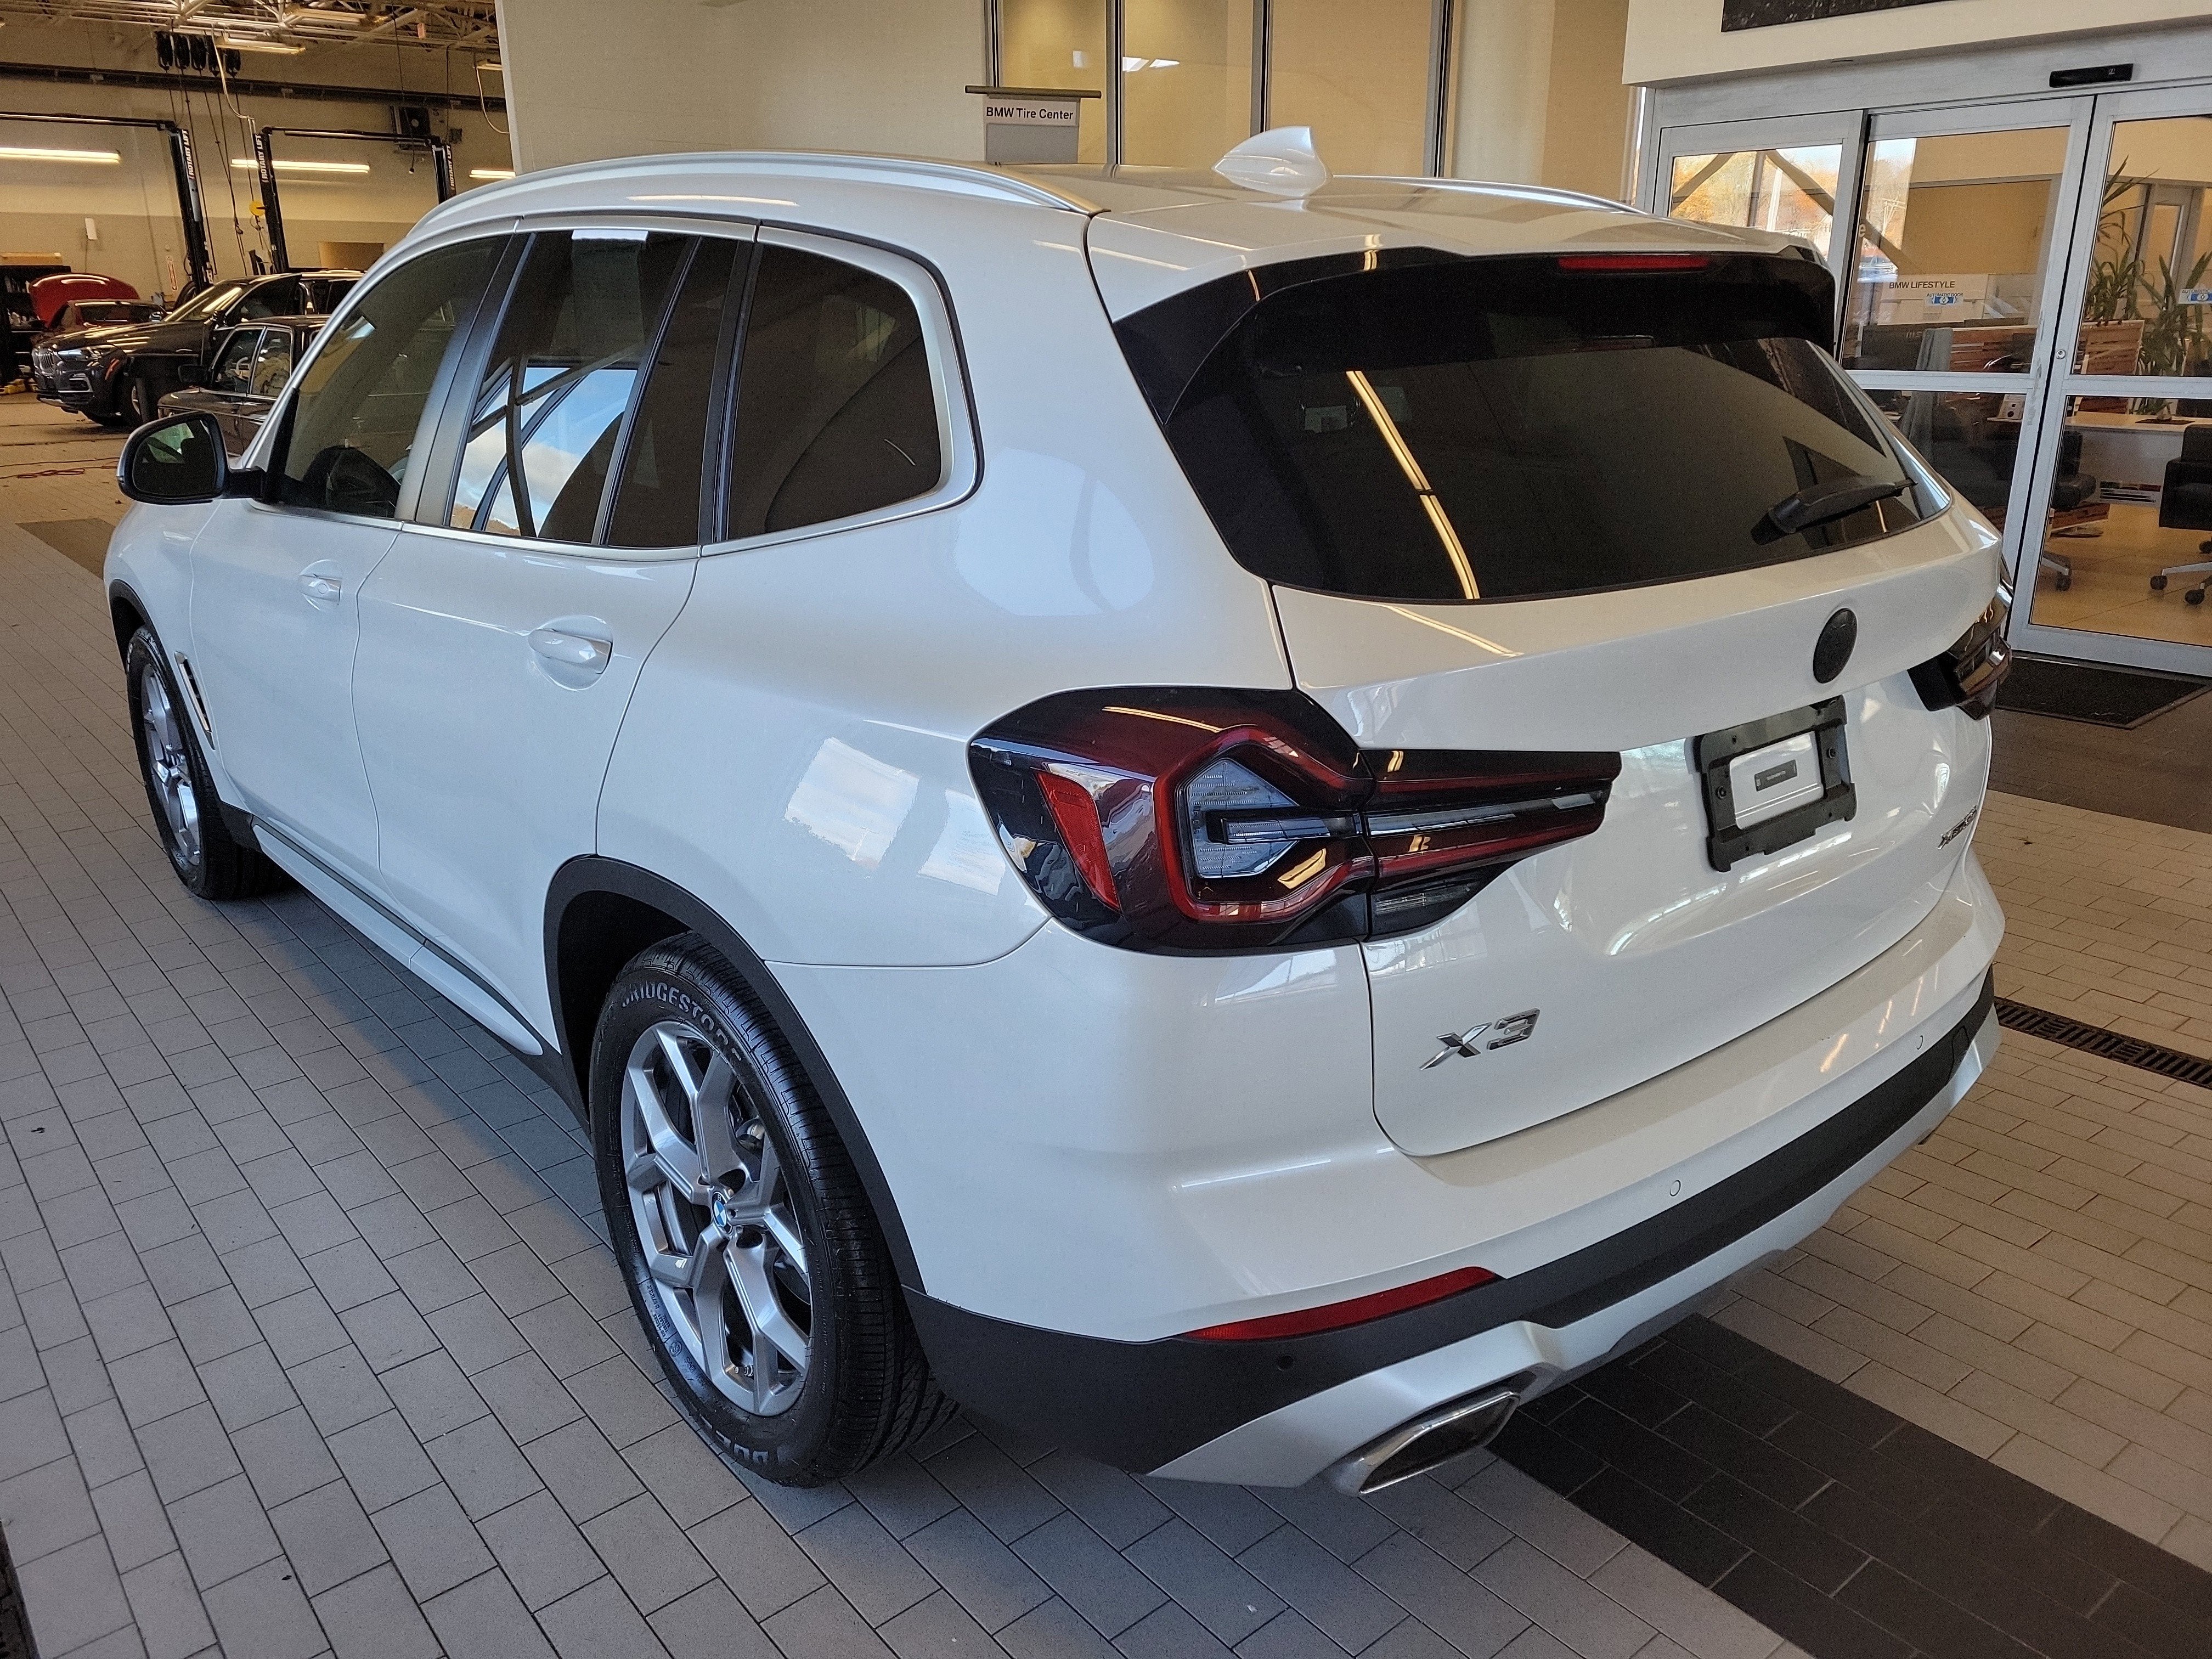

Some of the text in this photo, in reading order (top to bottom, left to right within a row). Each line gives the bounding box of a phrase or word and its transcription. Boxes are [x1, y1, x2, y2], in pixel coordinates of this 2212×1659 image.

[986, 106, 1074, 119] BMW Tire Center
[182, 129, 195, 176] ROTARY LIFT
[255, 134, 269, 179] ROTARY LIFT
[1419, 1008, 1541, 1070] X3
